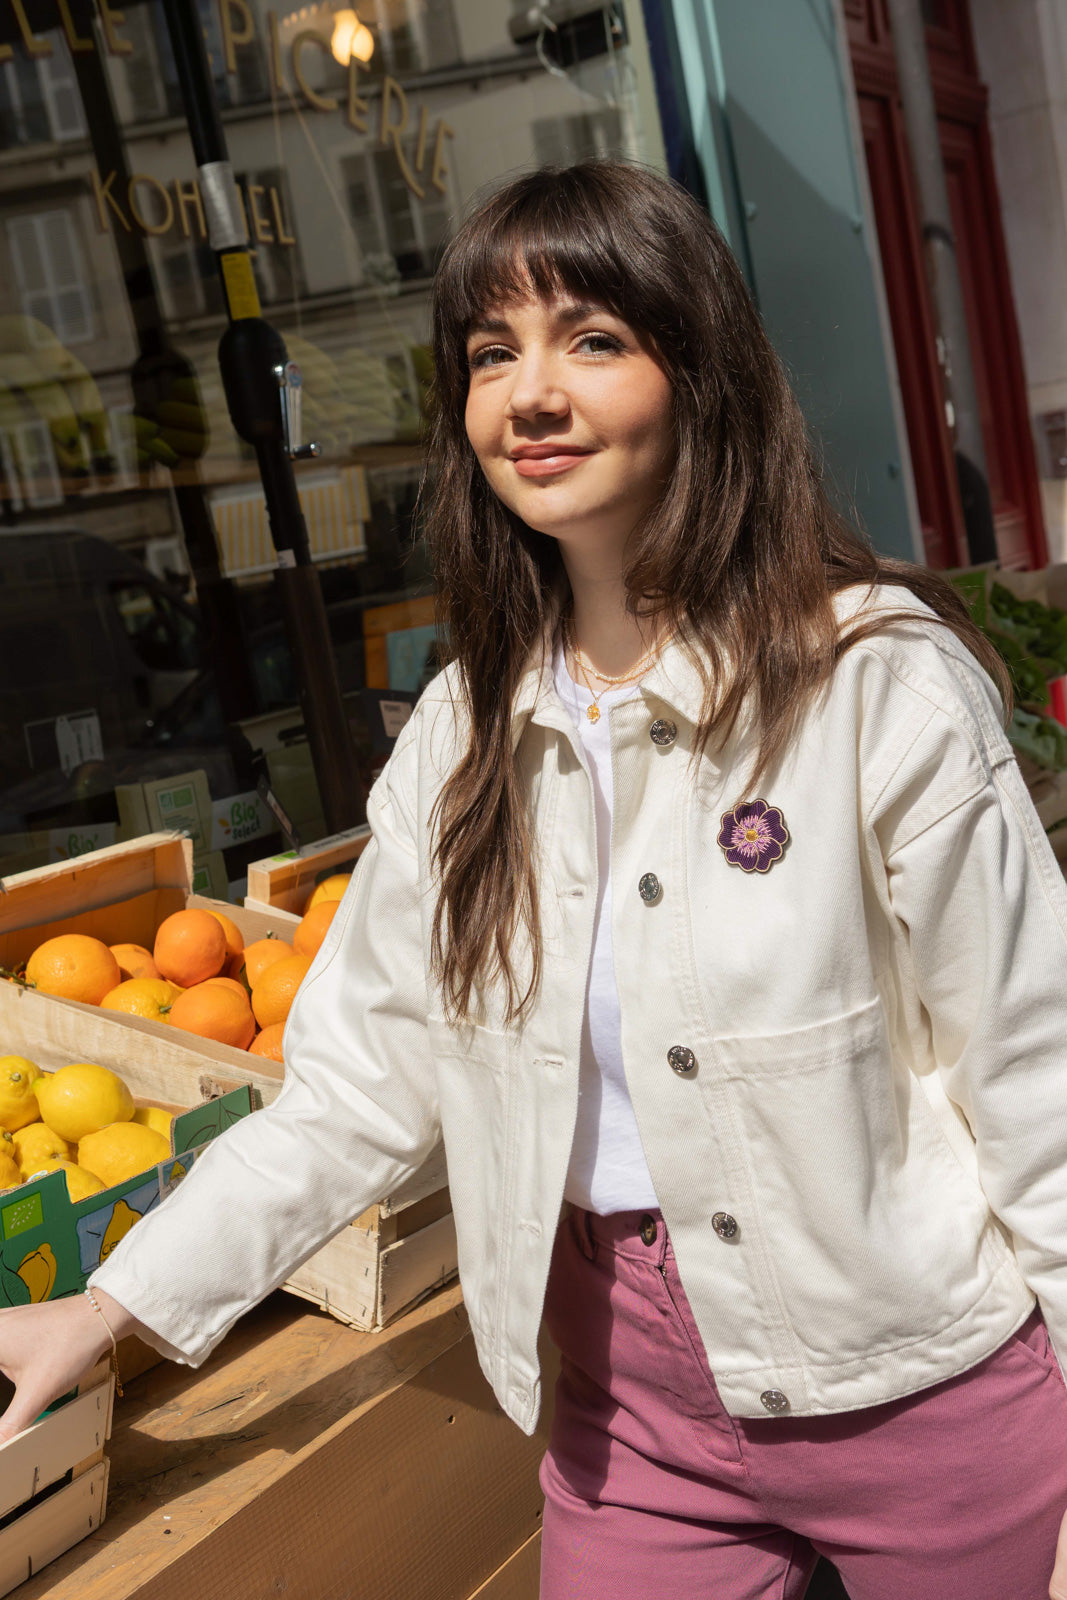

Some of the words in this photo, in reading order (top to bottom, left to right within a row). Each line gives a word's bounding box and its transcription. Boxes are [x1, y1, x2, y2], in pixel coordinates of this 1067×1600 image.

[203, 0, 456, 200] PICERIE
[89, 167, 296, 246] KOHEL
[232, 813, 262, 840] select
